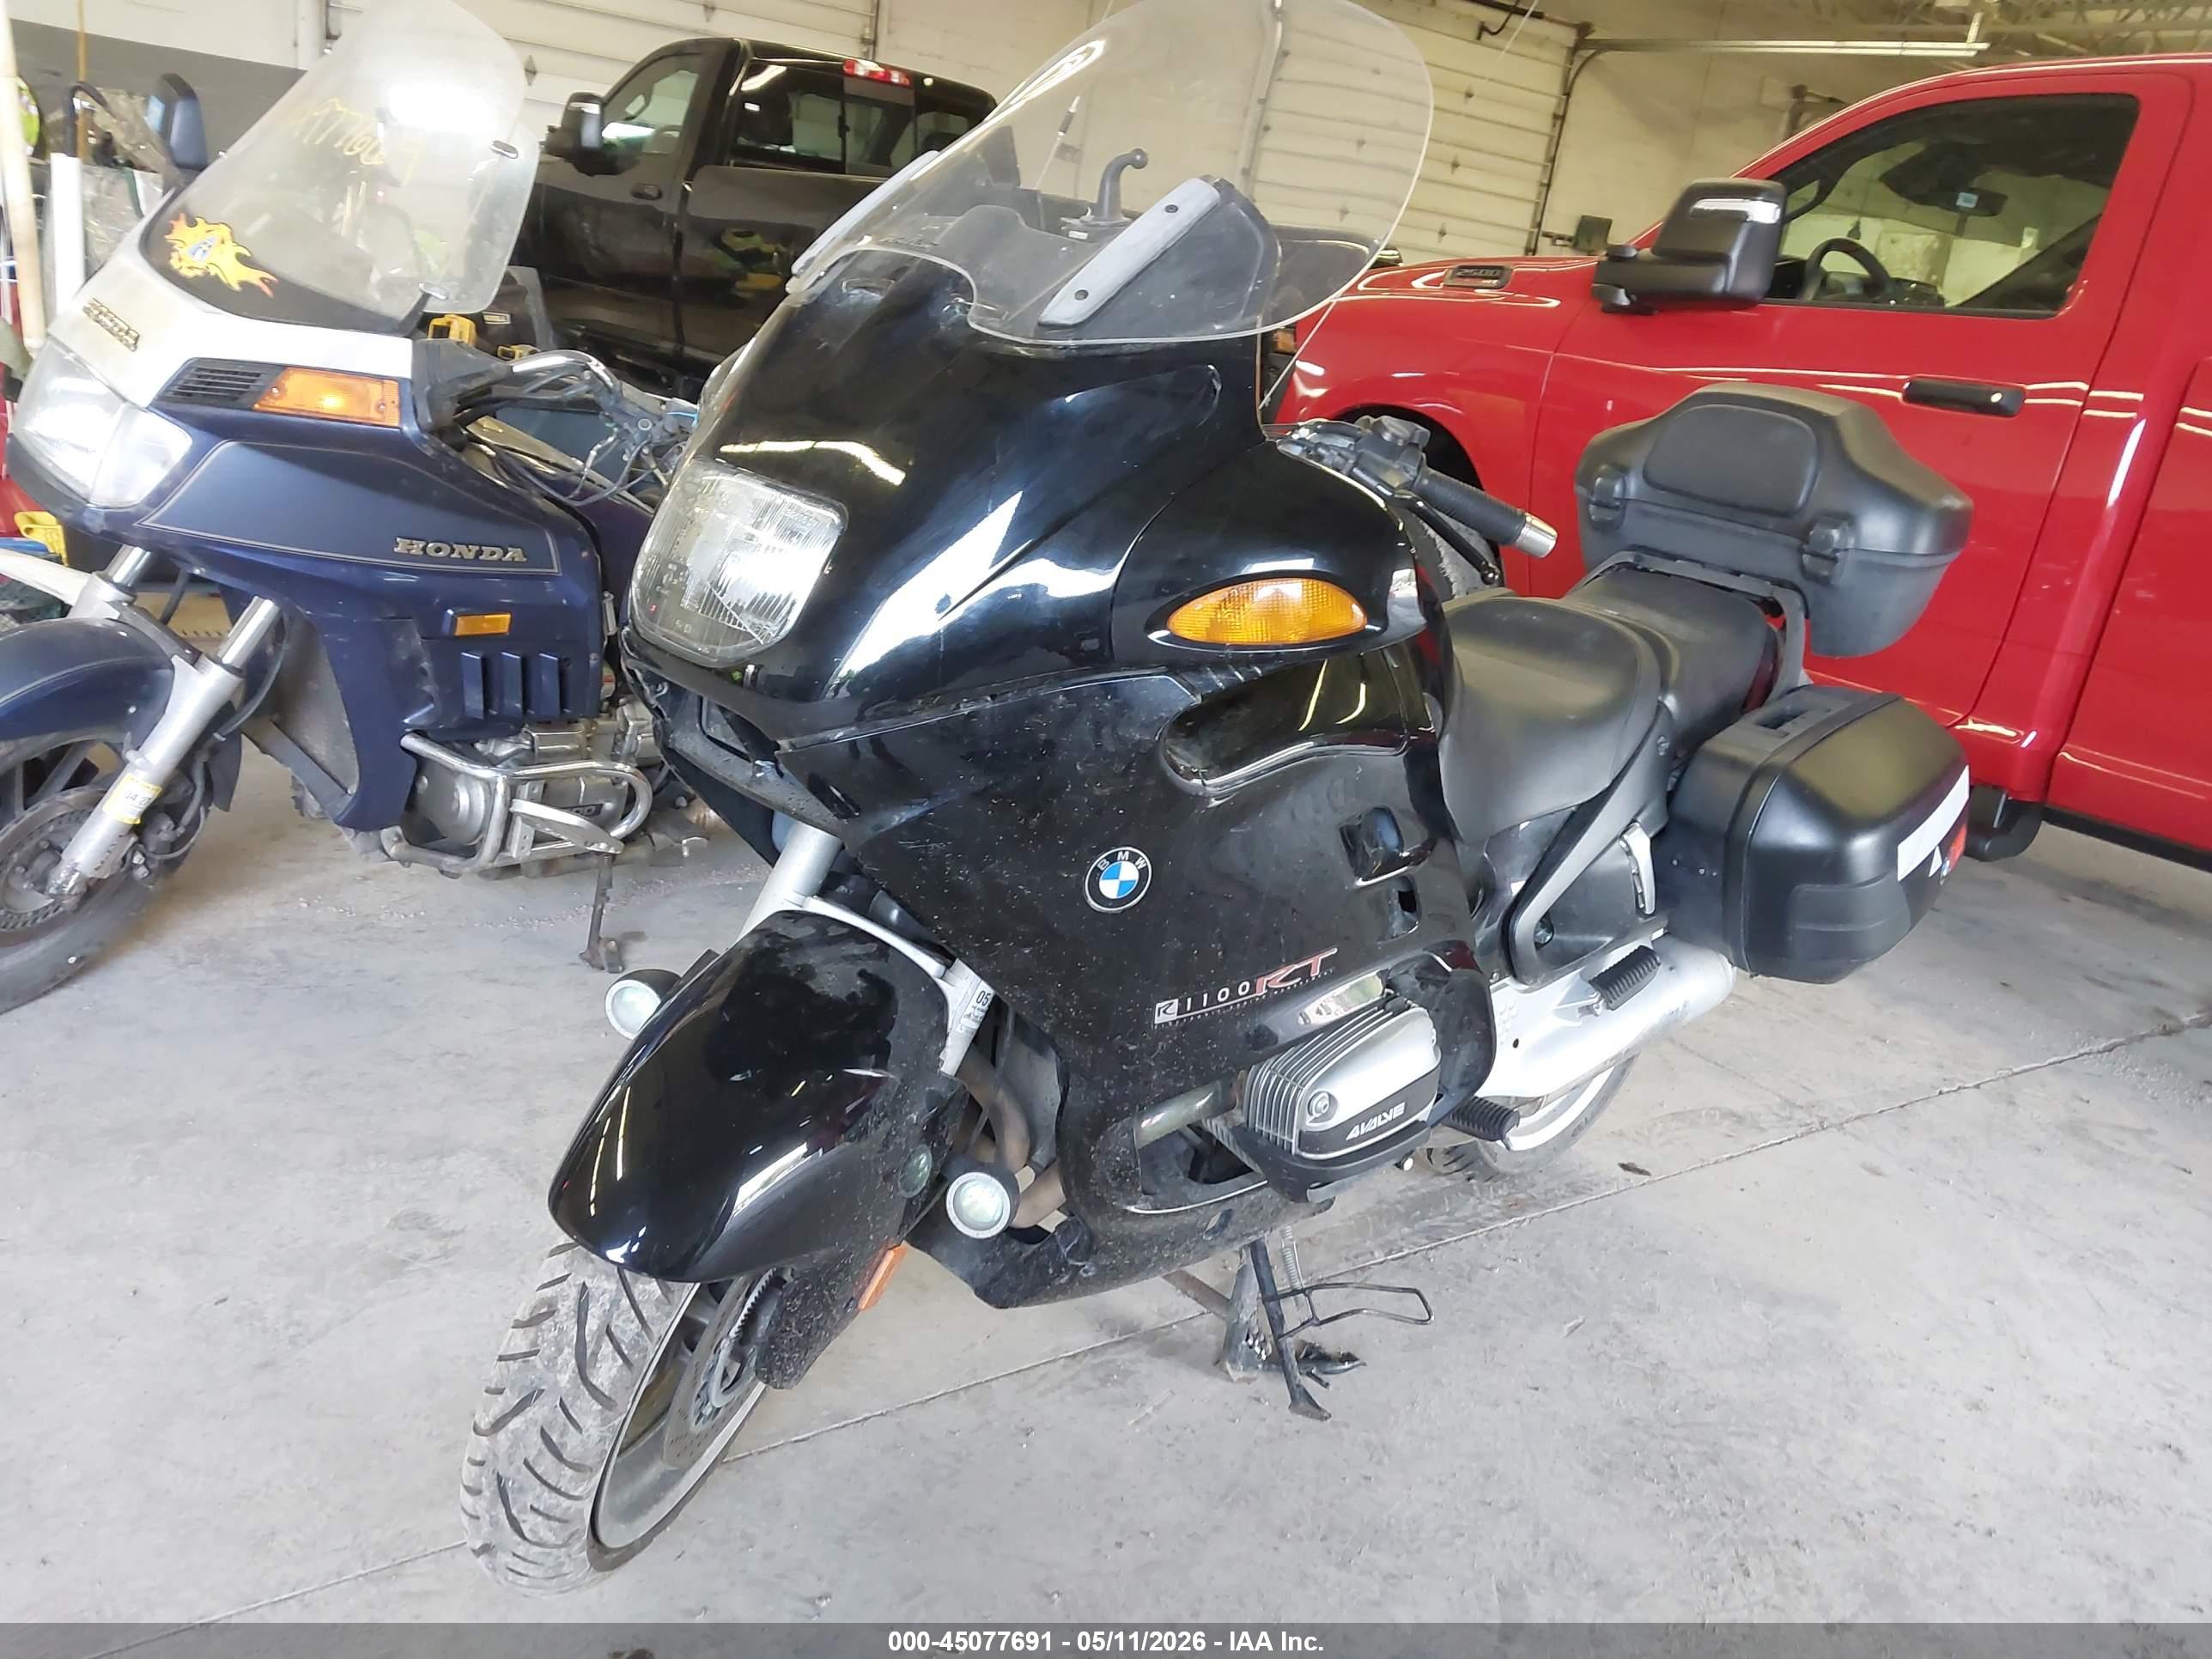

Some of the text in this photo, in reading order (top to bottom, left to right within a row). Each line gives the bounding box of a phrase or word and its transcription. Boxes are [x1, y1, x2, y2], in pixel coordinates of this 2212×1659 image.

[393, 537, 528, 562] HONDA
[1097, 851, 1147, 871] BMW
[975, 990, 991, 1006] 05
